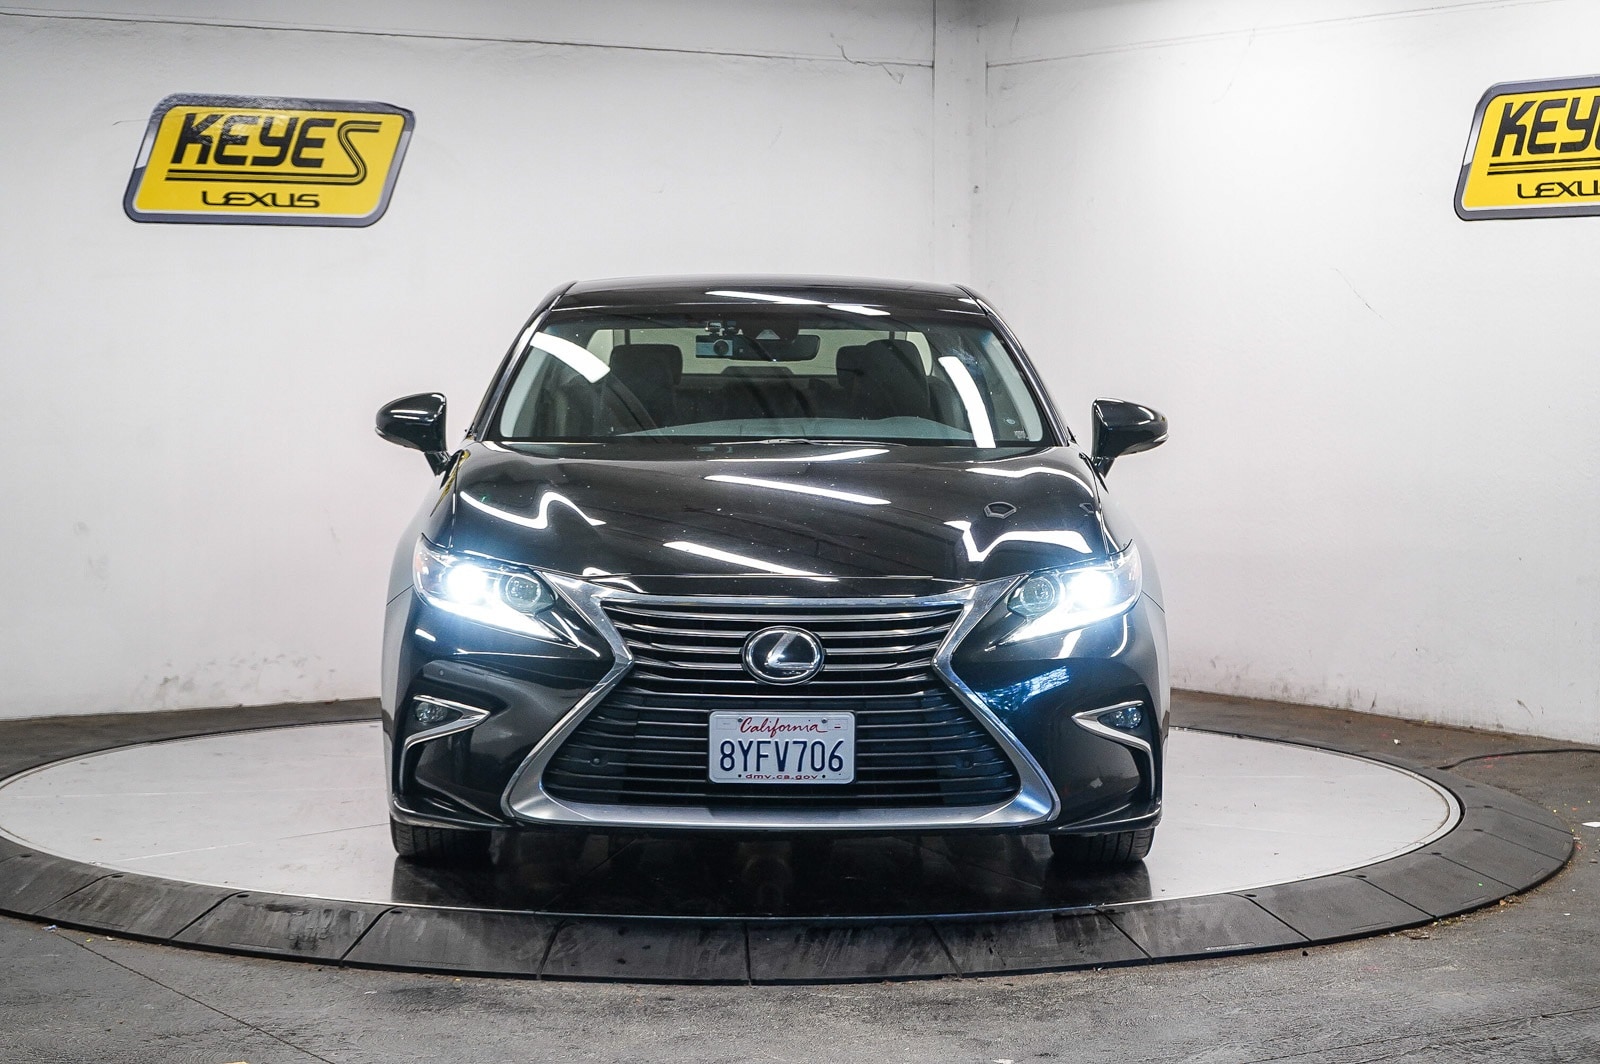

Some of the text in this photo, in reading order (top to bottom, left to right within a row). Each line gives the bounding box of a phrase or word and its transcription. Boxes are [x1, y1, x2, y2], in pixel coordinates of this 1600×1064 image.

[1491, 95, 1600, 158] KEY
[166, 112, 382, 185] KEYES
[201, 190, 320, 208] LEXUS
[1517, 180, 1600, 199] LEXU
[740, 716, 828, 738] California
[719, 740, 844, 772] 8YFV706
[745, 773, 819, 781] dmv.ca.gov
